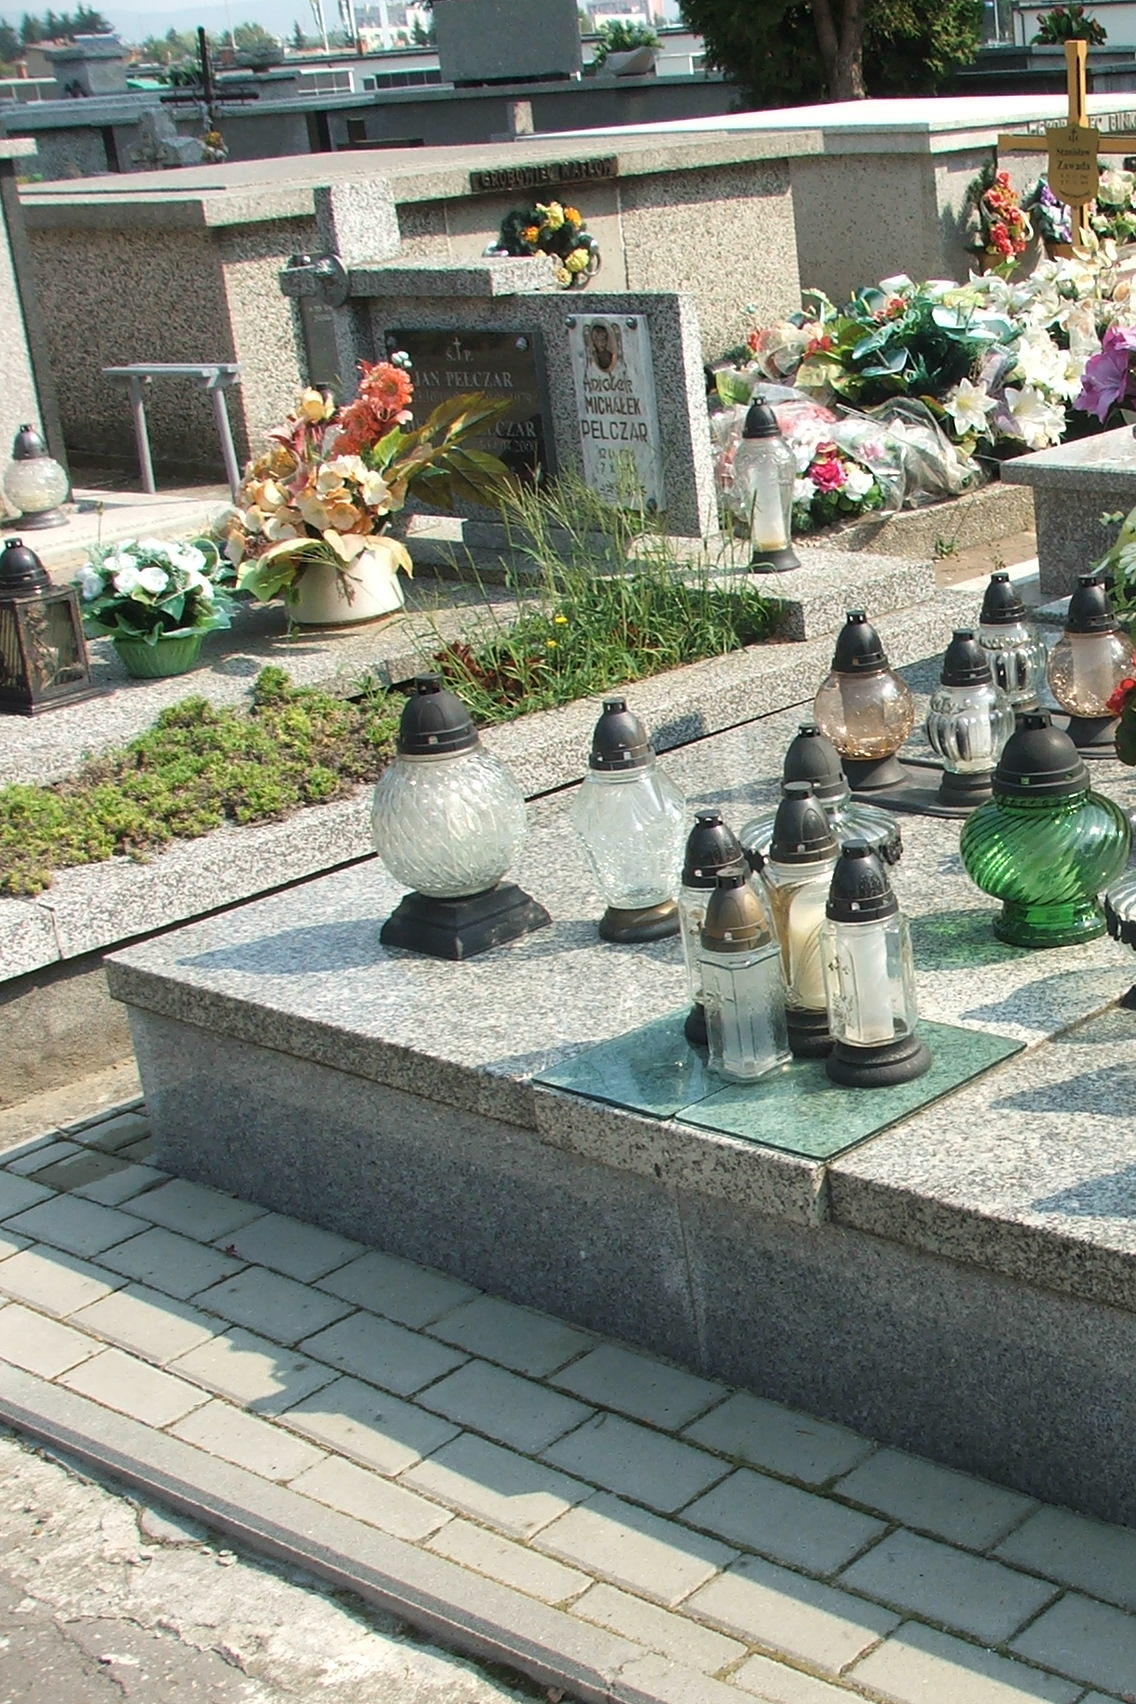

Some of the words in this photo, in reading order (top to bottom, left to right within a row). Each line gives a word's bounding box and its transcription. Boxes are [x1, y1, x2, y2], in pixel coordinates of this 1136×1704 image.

[445, 370, 513, 388] PELCZAR
[585, 395, 642, 416] MICHAŁEK
[581, 419, 648, 443] PELCZAR
